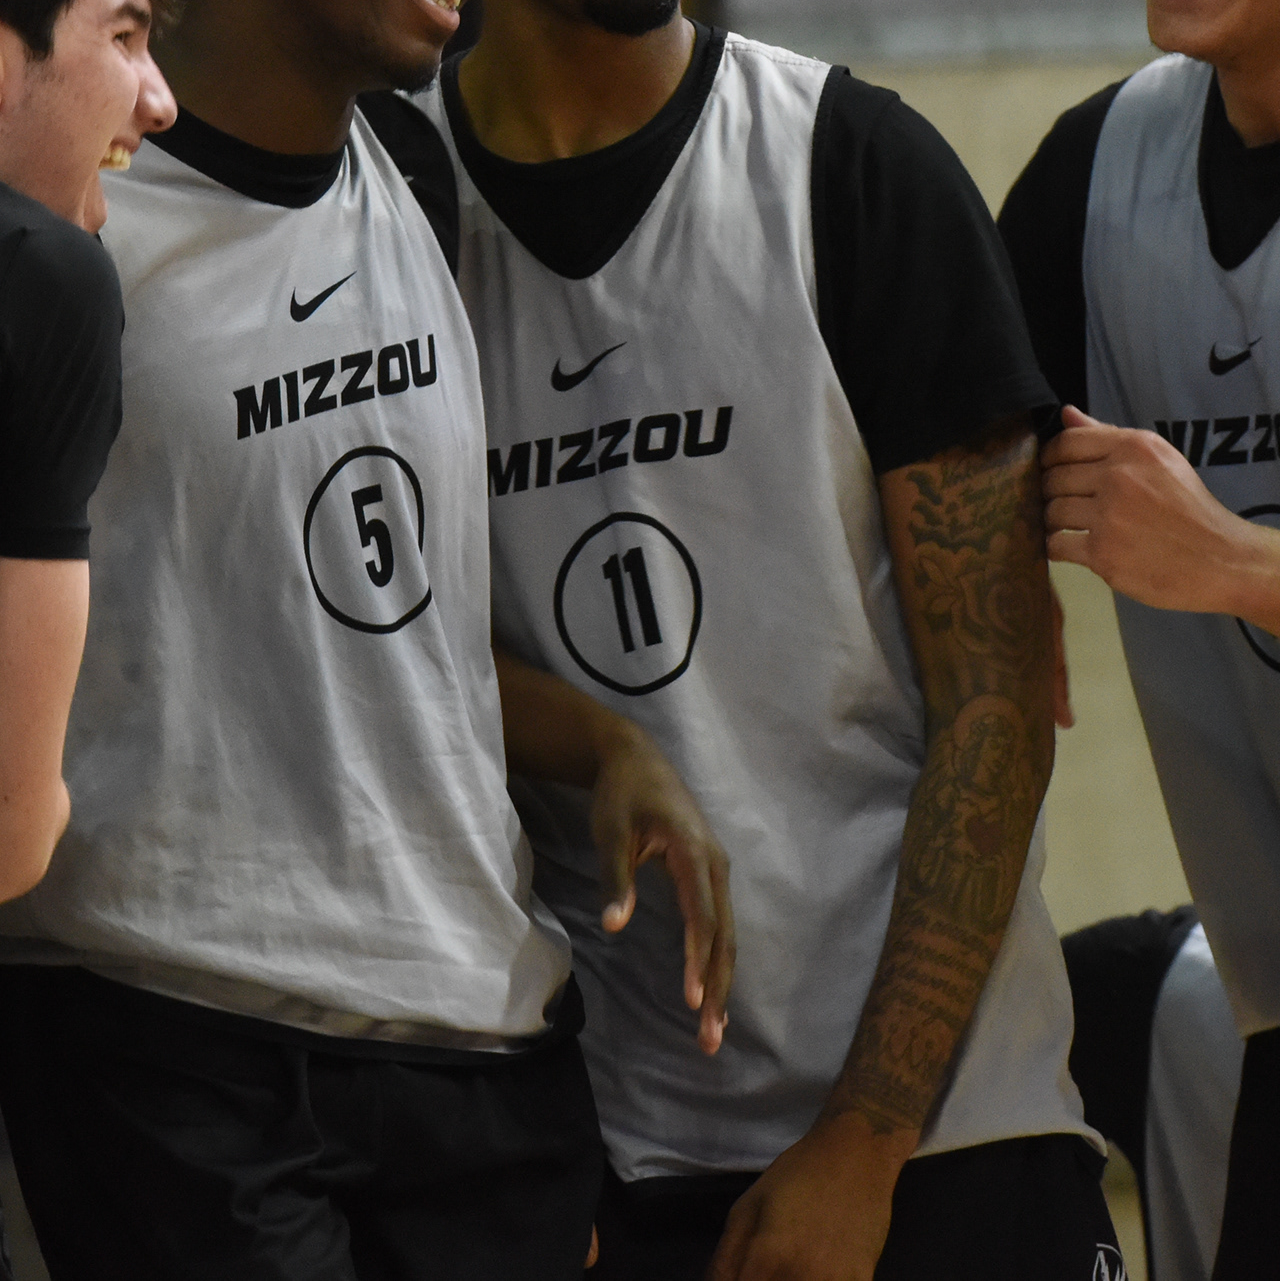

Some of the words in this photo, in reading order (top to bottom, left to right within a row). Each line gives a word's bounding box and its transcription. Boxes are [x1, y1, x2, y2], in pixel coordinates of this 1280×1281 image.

[233, 334, 438, 440] MIZZOU
[487, 406, 733, 498] MIZZOU
[351, 484, 395, 588] 5
[601, 546, 663, 654] 11
